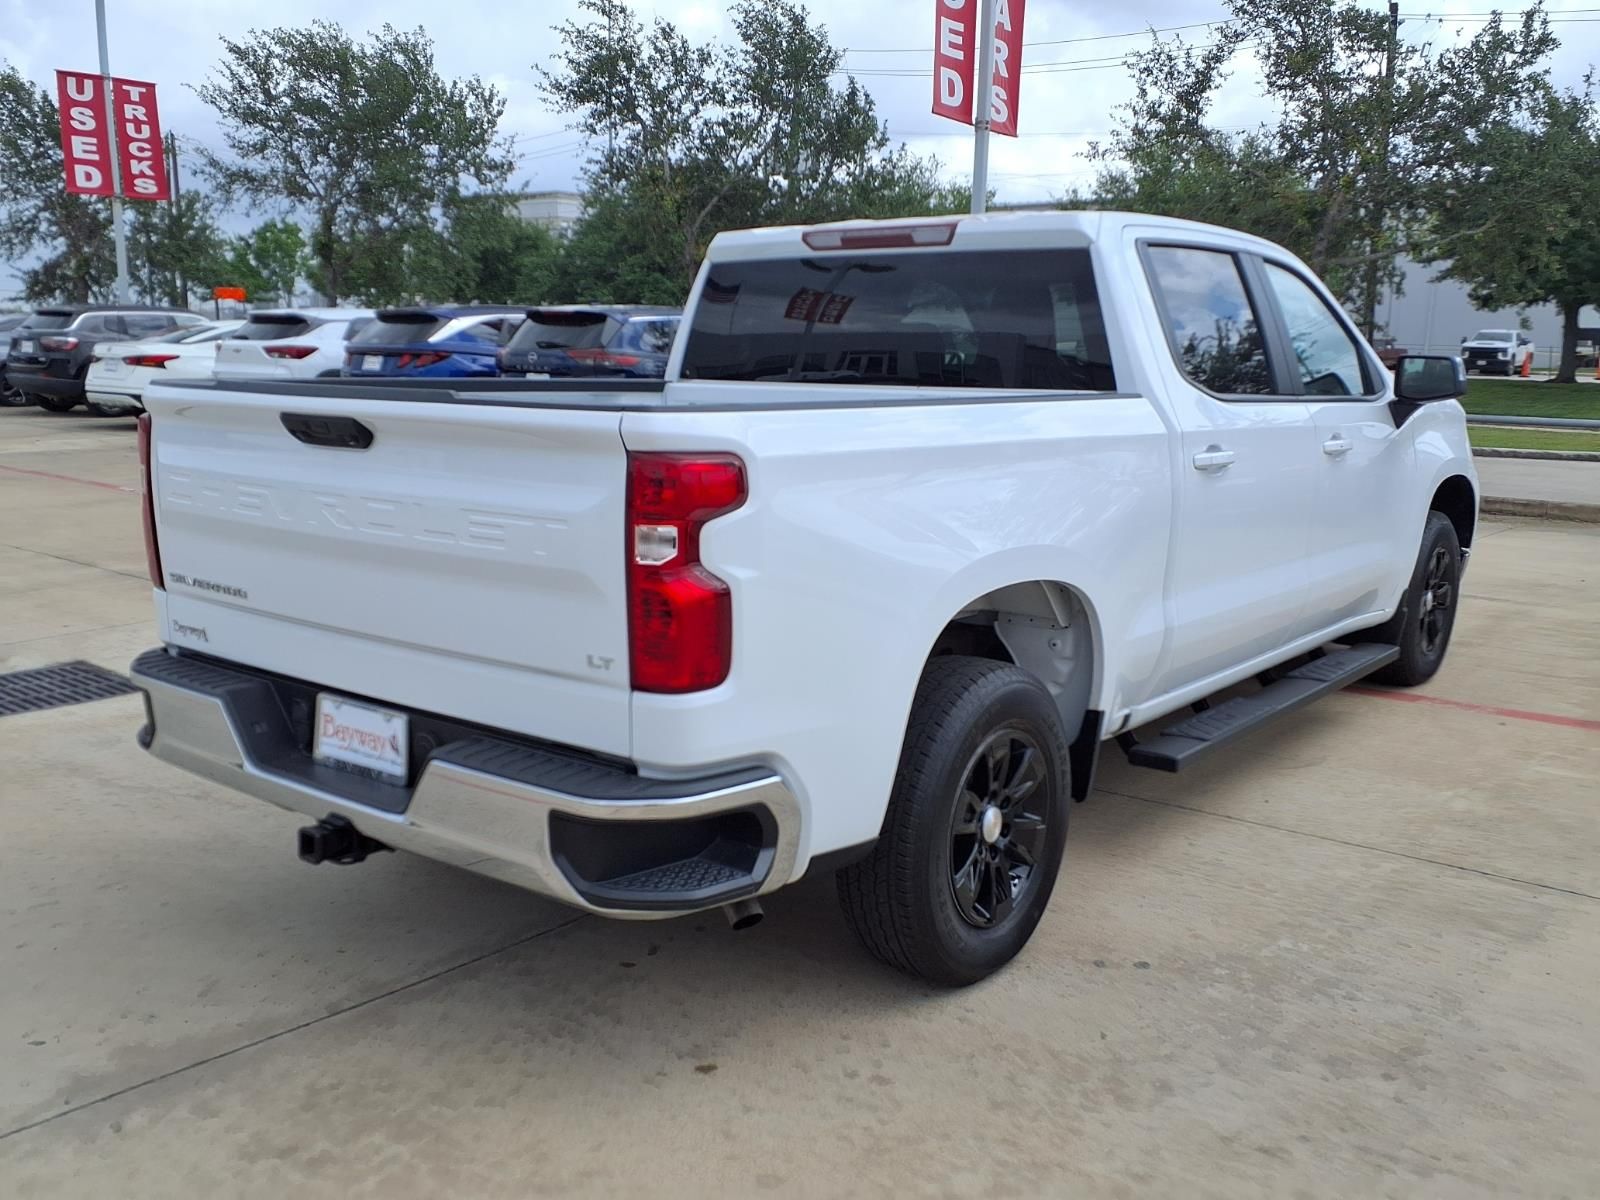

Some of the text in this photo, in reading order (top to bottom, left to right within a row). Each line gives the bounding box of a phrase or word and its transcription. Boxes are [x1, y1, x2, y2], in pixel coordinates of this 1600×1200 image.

[941, 0, 965, 108] ED
[66, 76, 102, 188] USED
[122, 84, 158, 194] TRUCKS
[167, 471, 569, 557] CHEVROLET
[586, 654, 615, 671] LT
[322, 713, 387, 758] Bayway
